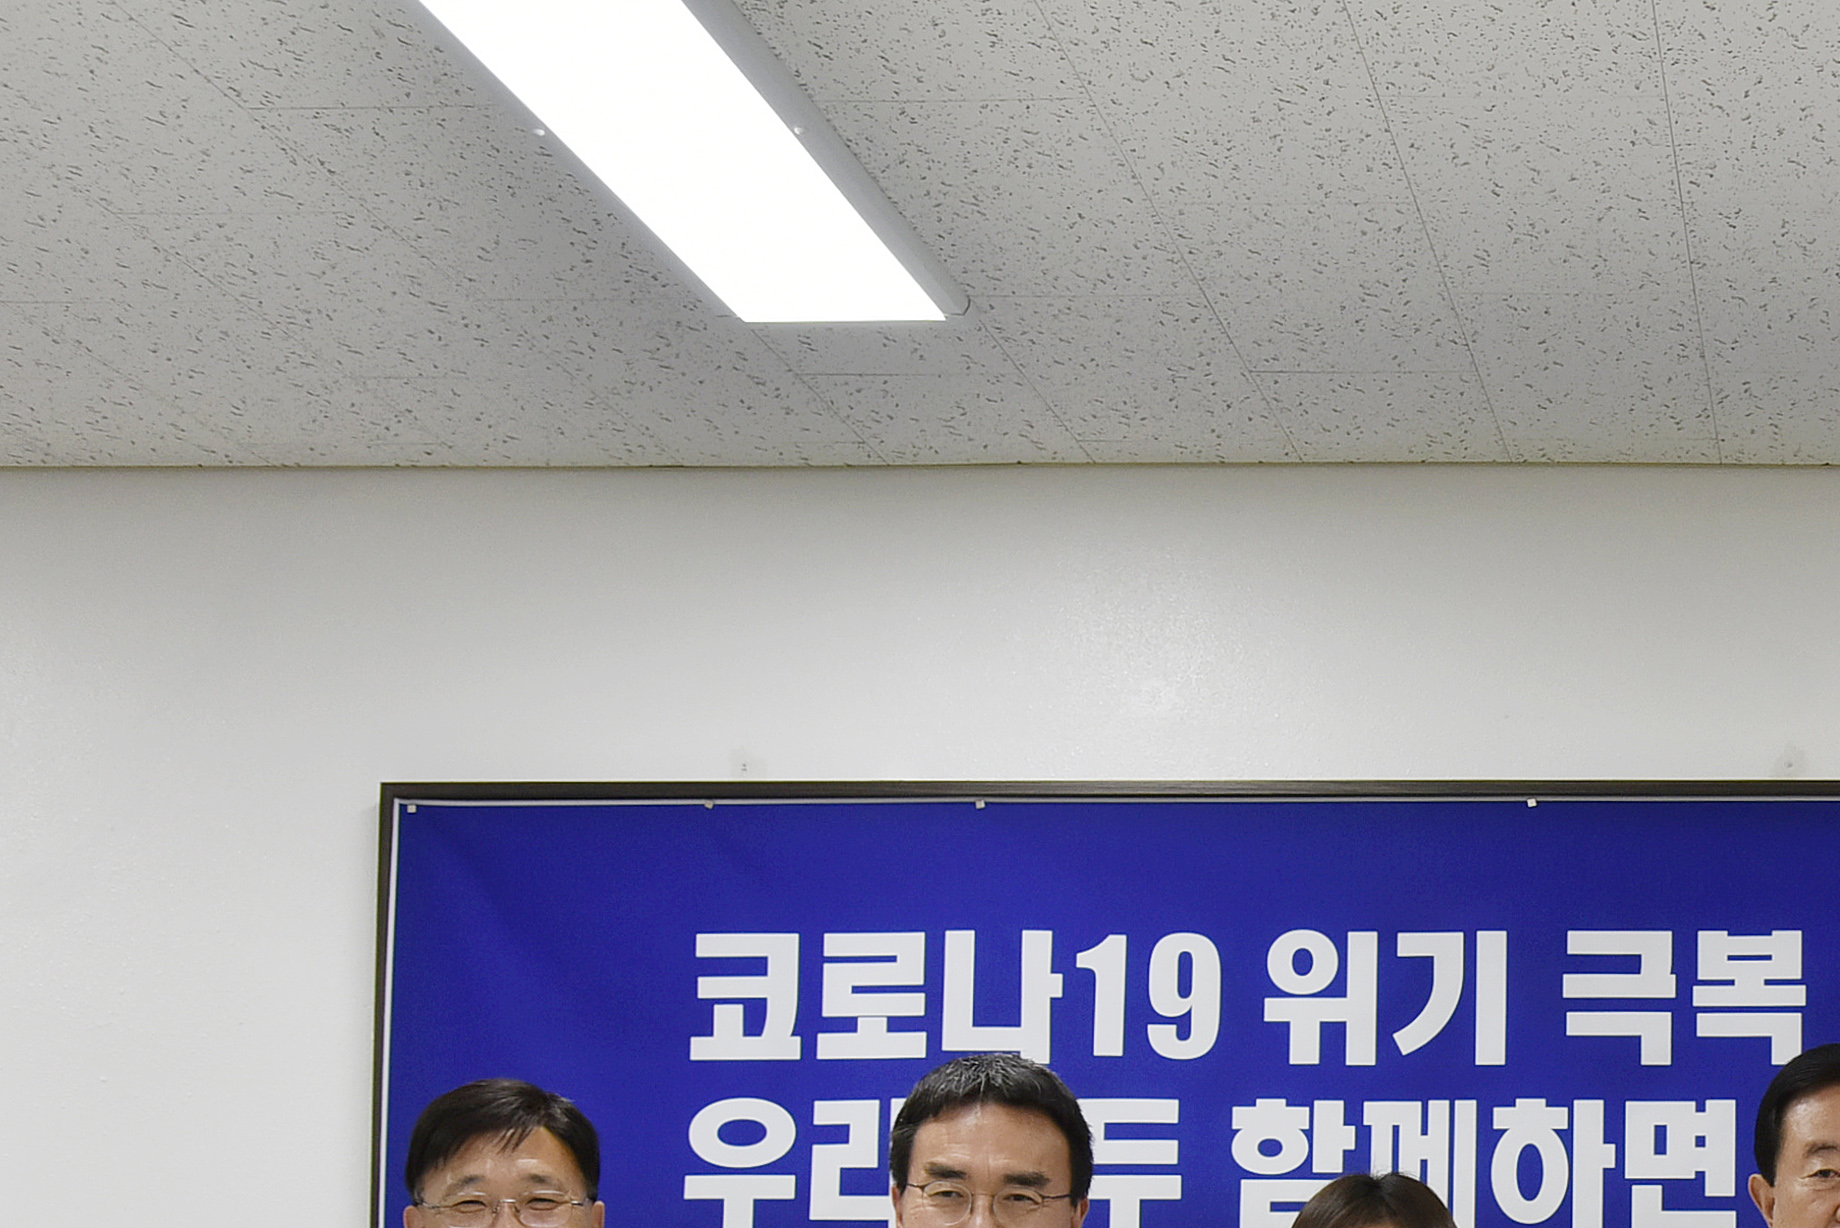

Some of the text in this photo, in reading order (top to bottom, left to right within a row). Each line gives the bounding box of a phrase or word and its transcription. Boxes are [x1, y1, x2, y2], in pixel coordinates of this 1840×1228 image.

[689, 928, 1807, 1066] 코로나19 위기 극복
